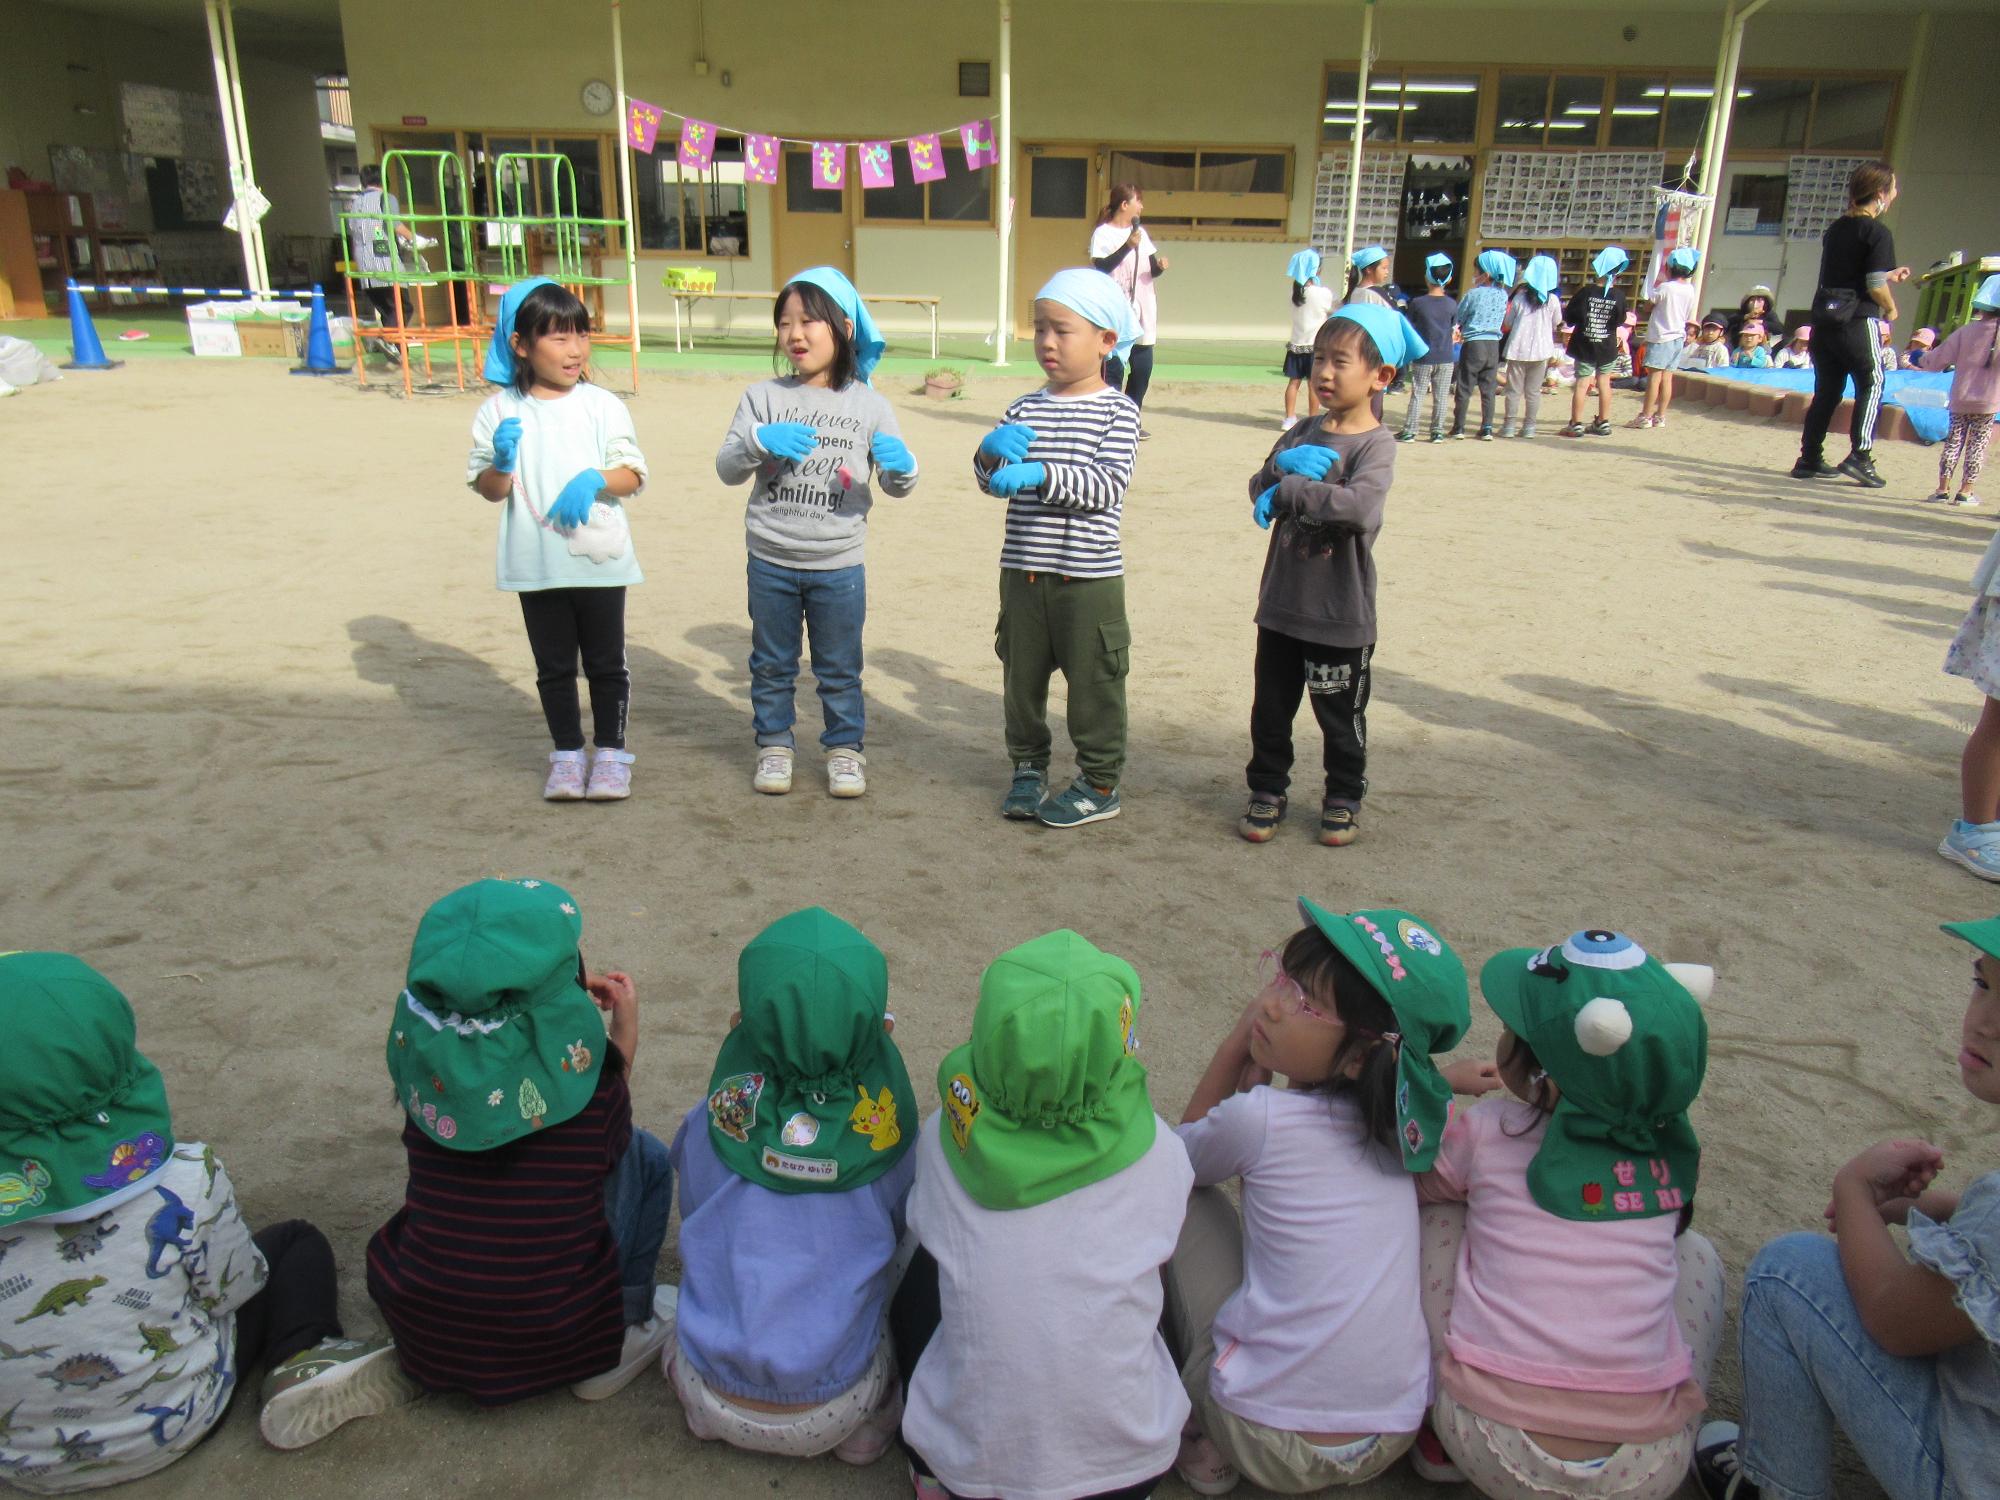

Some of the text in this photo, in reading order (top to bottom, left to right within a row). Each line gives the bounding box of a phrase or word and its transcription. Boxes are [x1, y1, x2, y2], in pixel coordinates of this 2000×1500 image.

[767, 481, 846, 514] Smiling!
[770, 506, 826, 521] delightful day
[1613, 1159, 1671, 1188] せり
